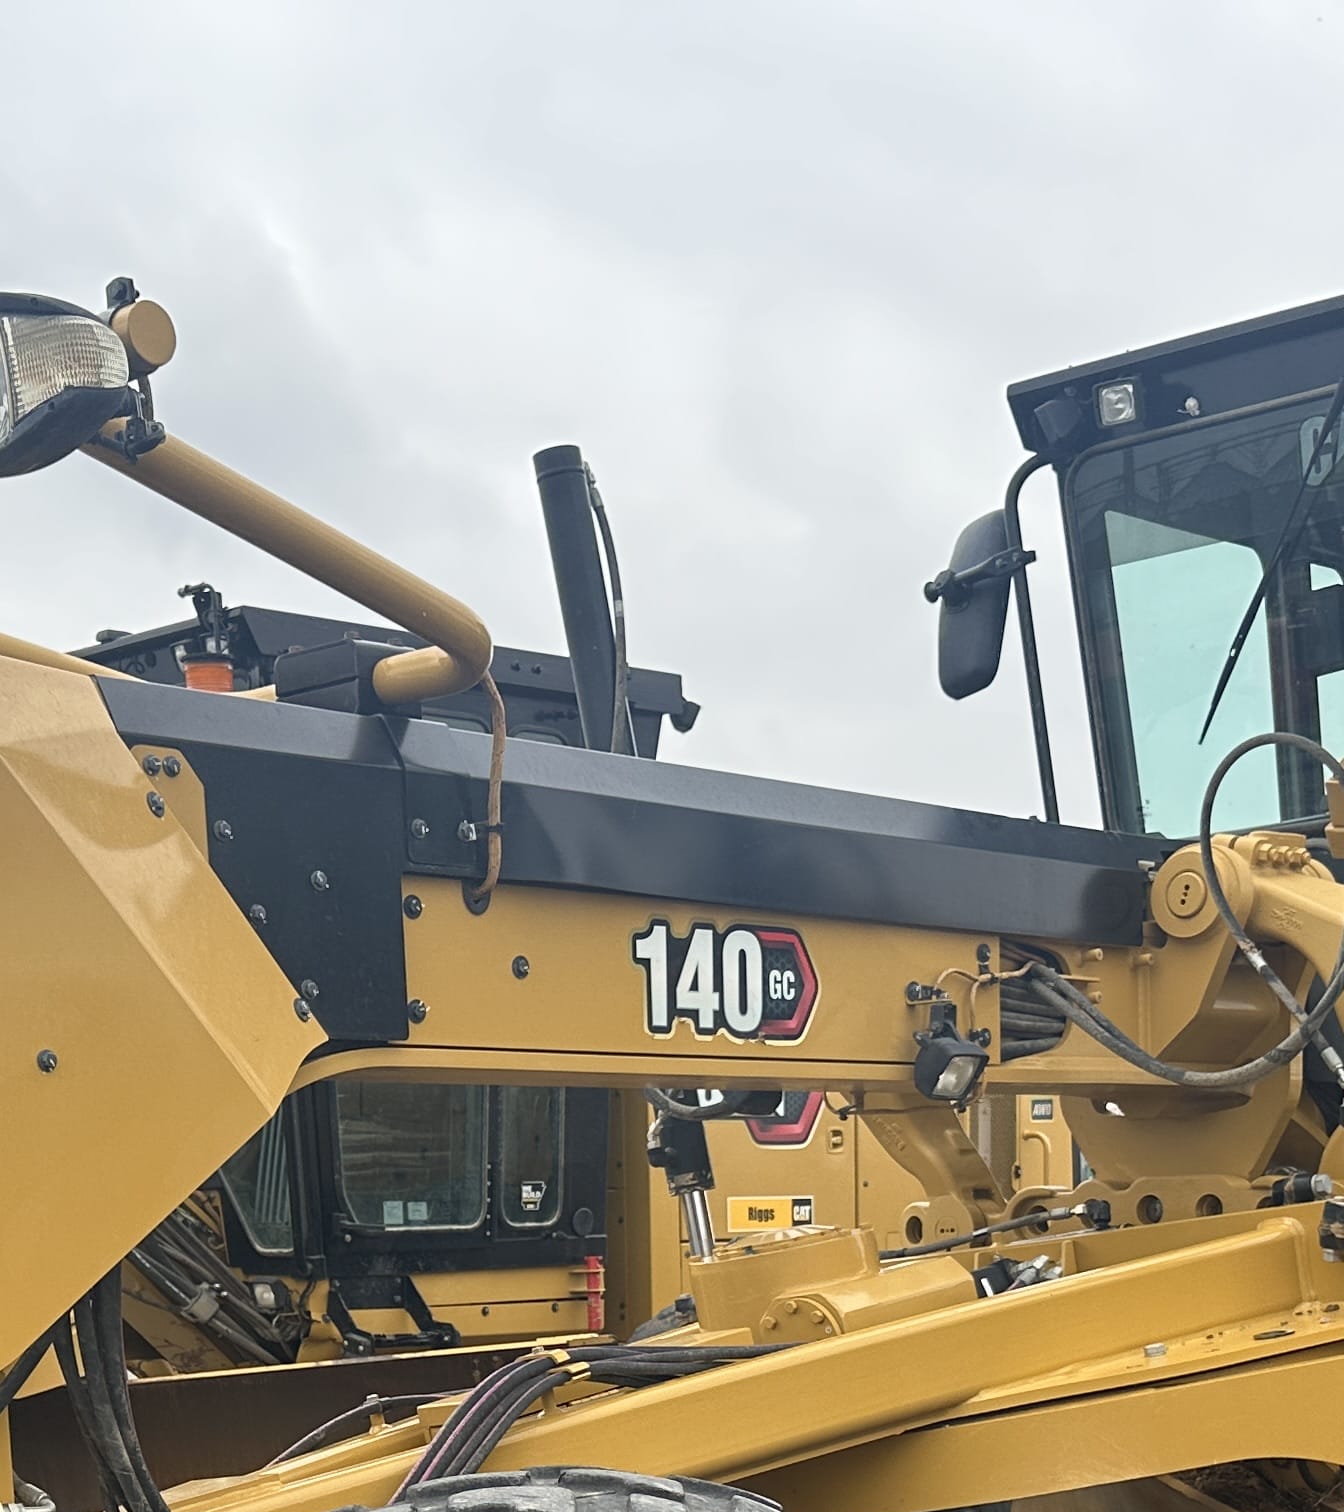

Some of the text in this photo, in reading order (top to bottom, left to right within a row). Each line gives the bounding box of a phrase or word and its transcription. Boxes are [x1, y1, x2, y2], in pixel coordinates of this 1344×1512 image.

[635, 925, 796, 1033] 140 GC
[748, 1205, 811, 1222] Riggs CAT
